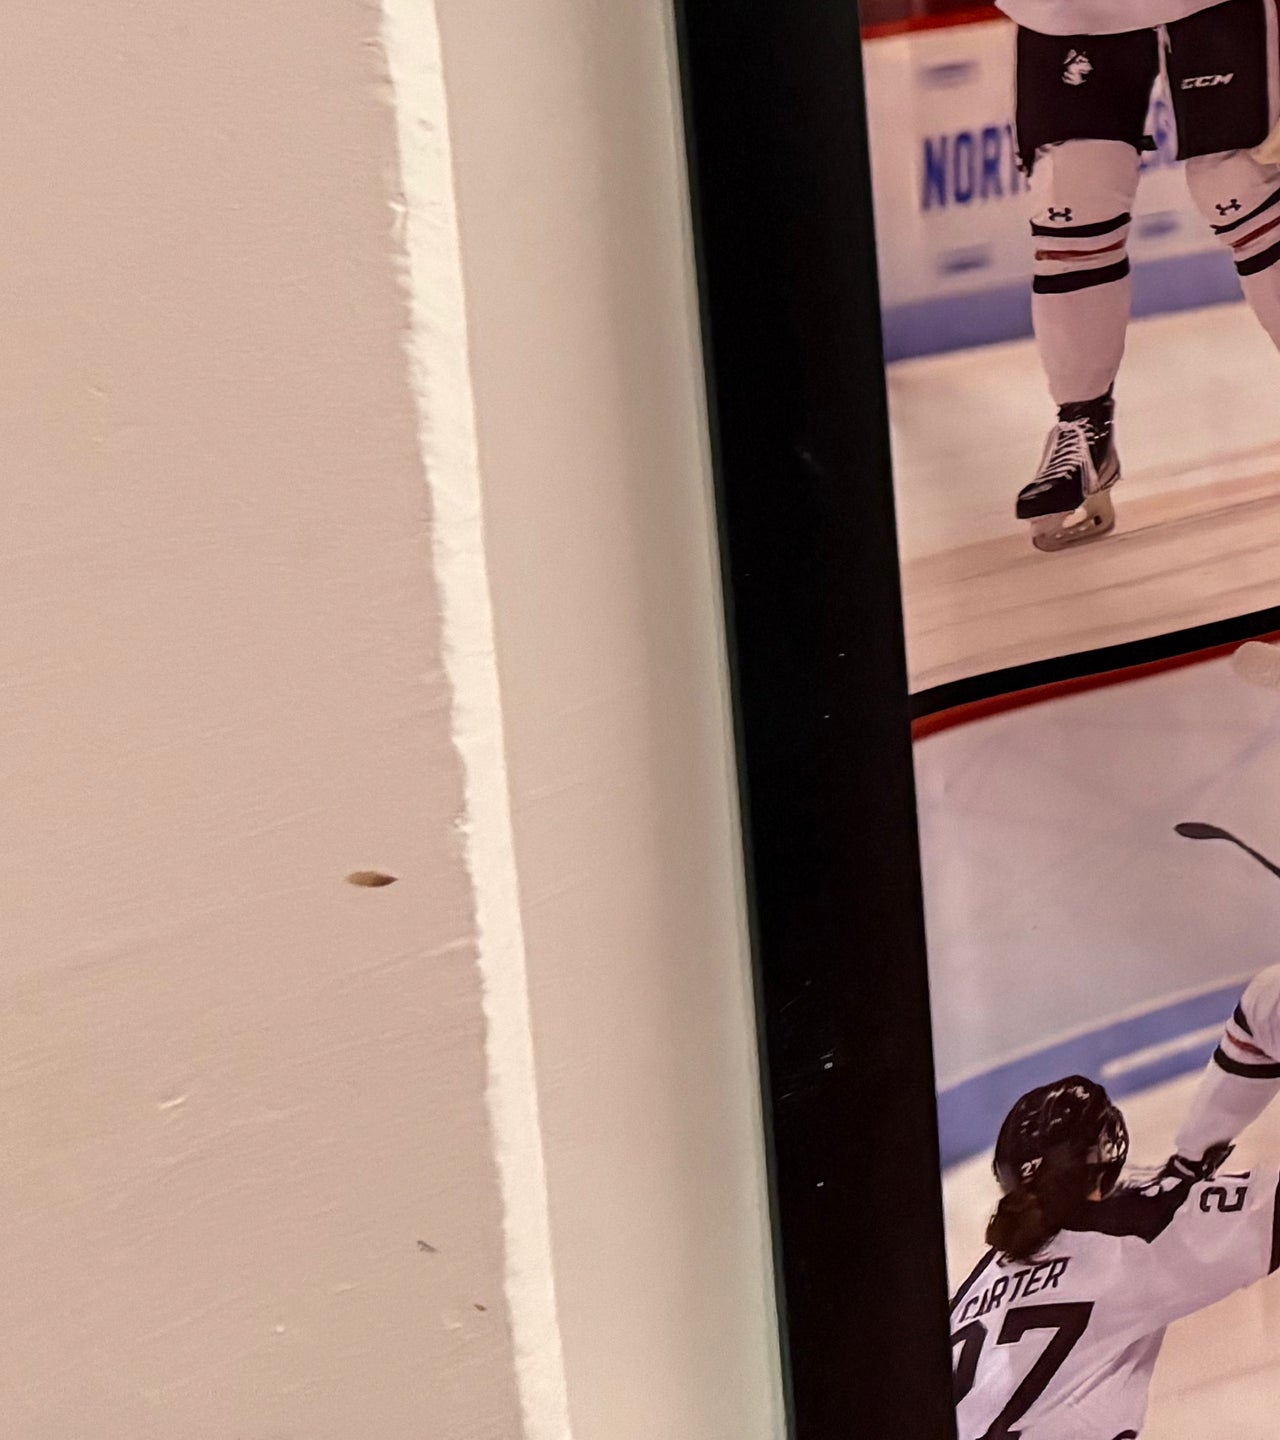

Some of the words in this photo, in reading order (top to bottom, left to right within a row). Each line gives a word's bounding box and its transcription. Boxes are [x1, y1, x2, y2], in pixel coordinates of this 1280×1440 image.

[1181, 72, 1235, 90] CCM
[1020, 1156, 1043, 1178] 27
[958, 1255, 1071, 1324] CARTER
